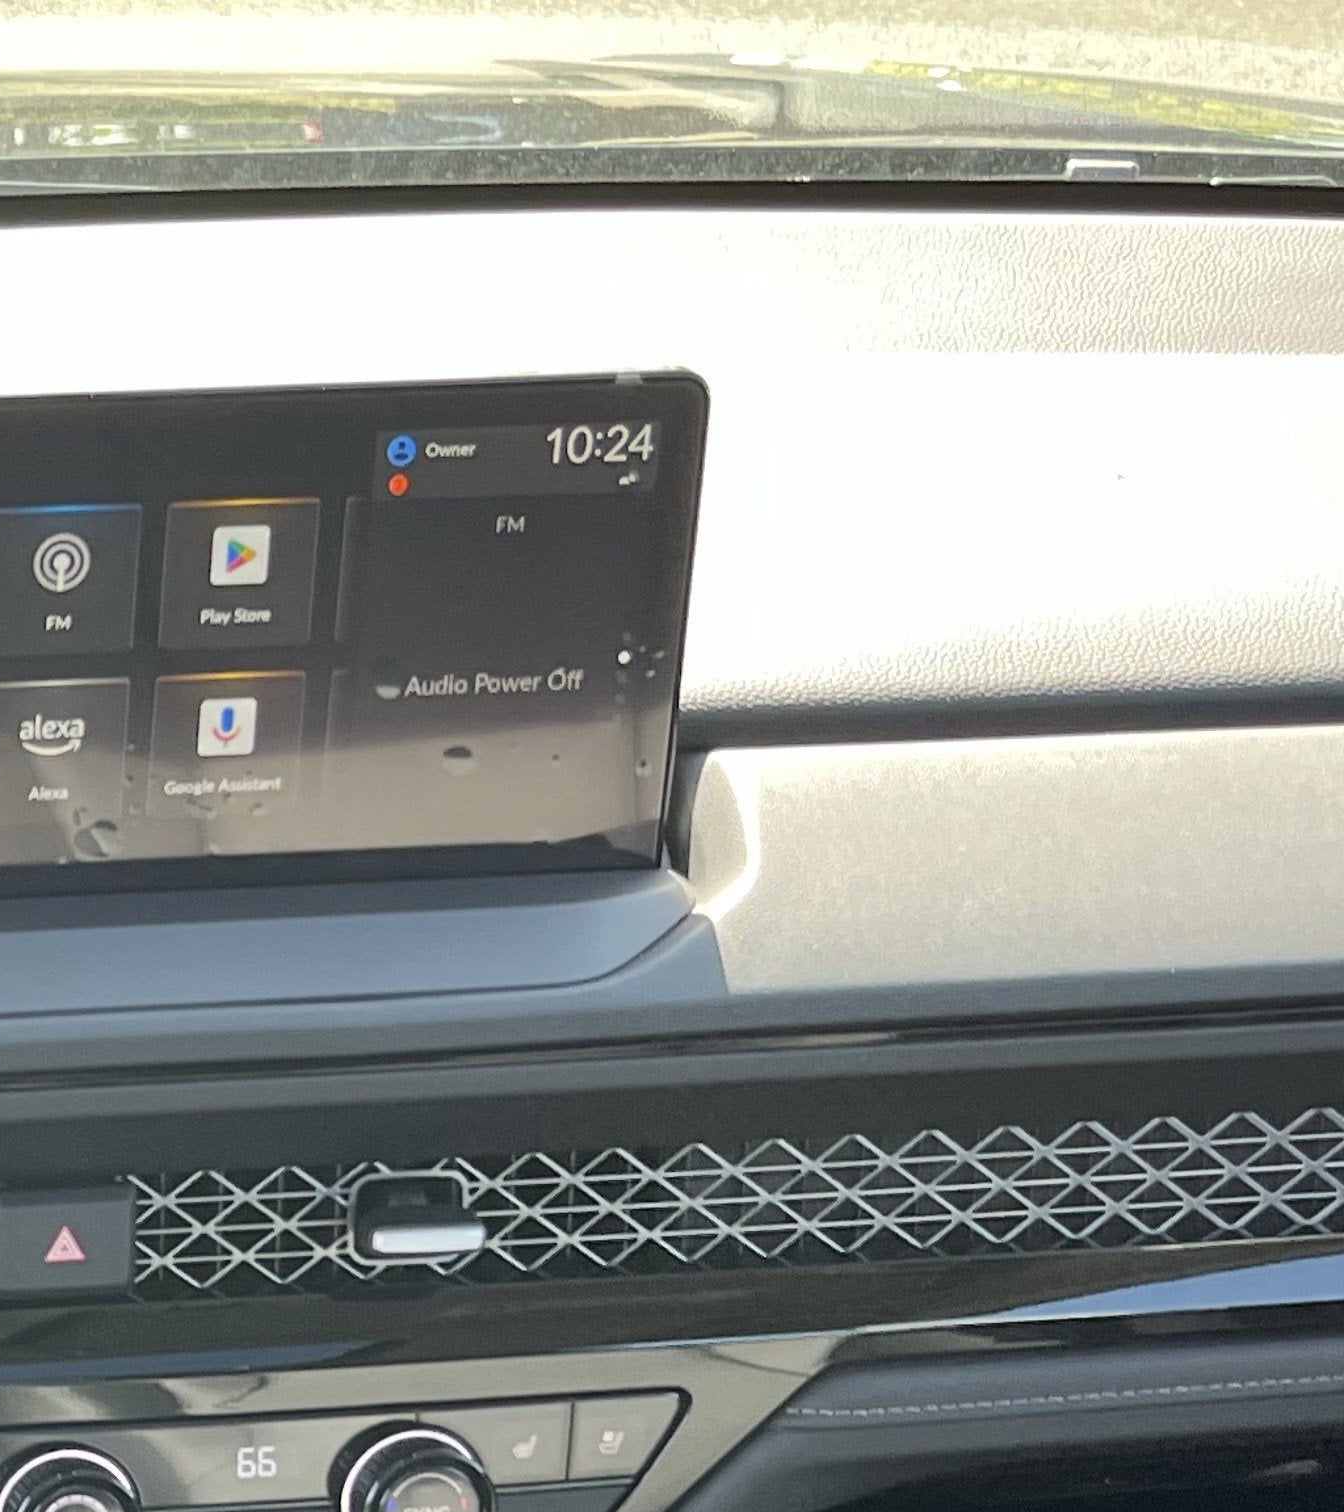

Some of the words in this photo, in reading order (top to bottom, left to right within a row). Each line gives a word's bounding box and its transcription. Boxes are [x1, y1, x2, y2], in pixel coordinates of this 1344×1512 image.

[425, 442, 476, 458] Owner
[547, 423, 654, 464] 10:24
[496, 516, 525, 533] FM
[45, 614, 71, 630] FM
[200, 608, 230, 627] Play
[234, 607, 271, 624] Store
[405, 671, 468, 697] Audio
[475, 669, 540, 694] Power
[548, 667, 584, 693] Off
[19, 716, 86, 743] alexa
[28, 785, 68, 801] Alexa
[164, 777, 215, 797] Google
[218, 776, 282, 794] Assistant
[237, 1446, 277, 1480] 66
